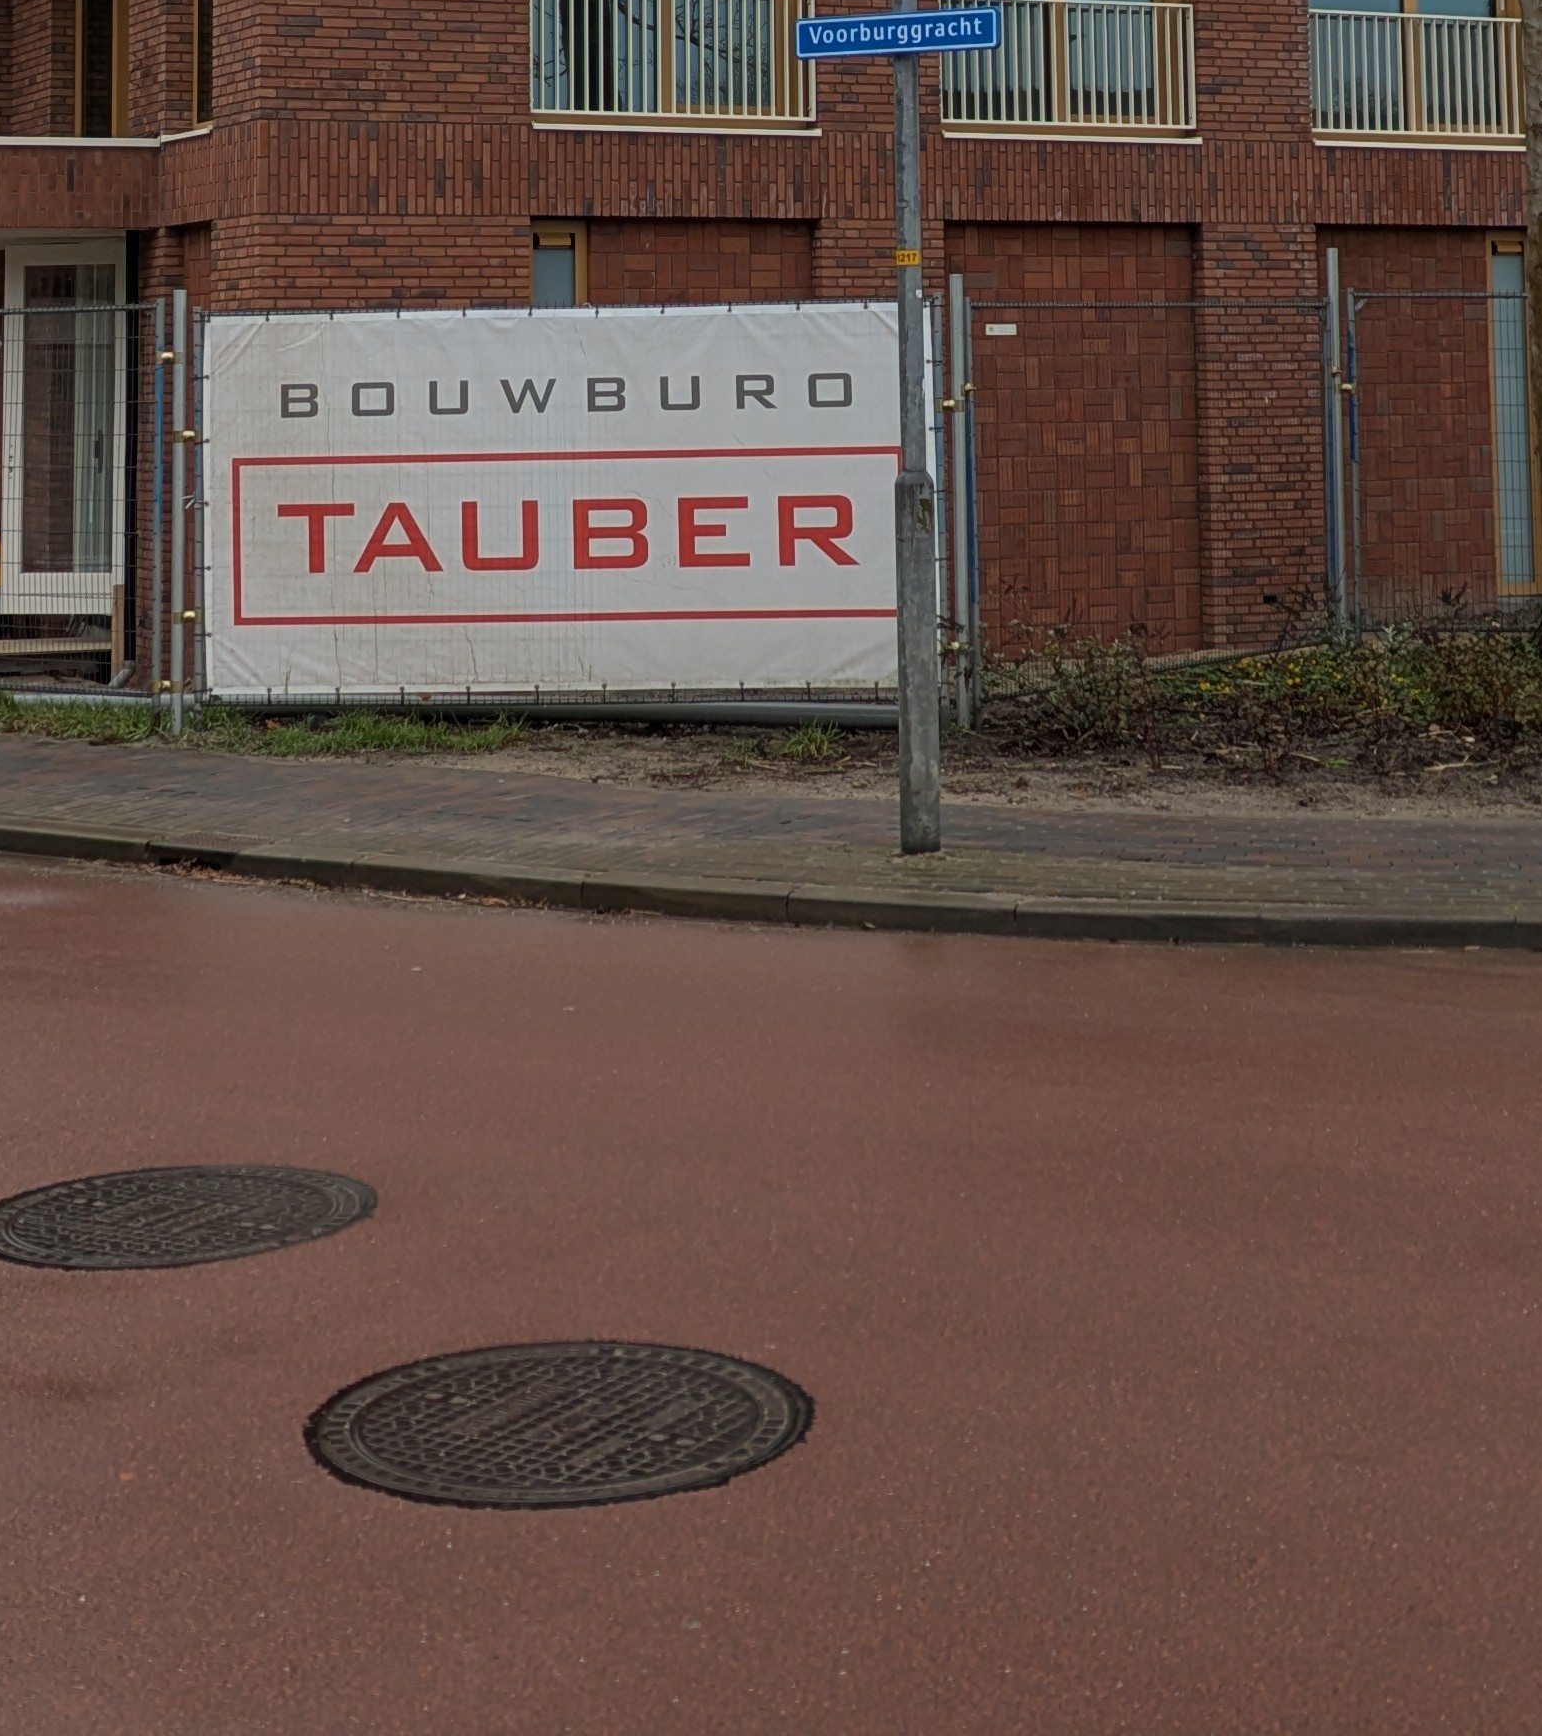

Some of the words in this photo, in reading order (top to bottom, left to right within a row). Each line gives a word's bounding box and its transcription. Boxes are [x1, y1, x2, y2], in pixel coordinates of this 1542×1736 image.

[809, 17, 982, 45] Voorburggracht
[280, 371, 854, 419] BOUWBURO
[277, 494, 860, 574] TAUBER
